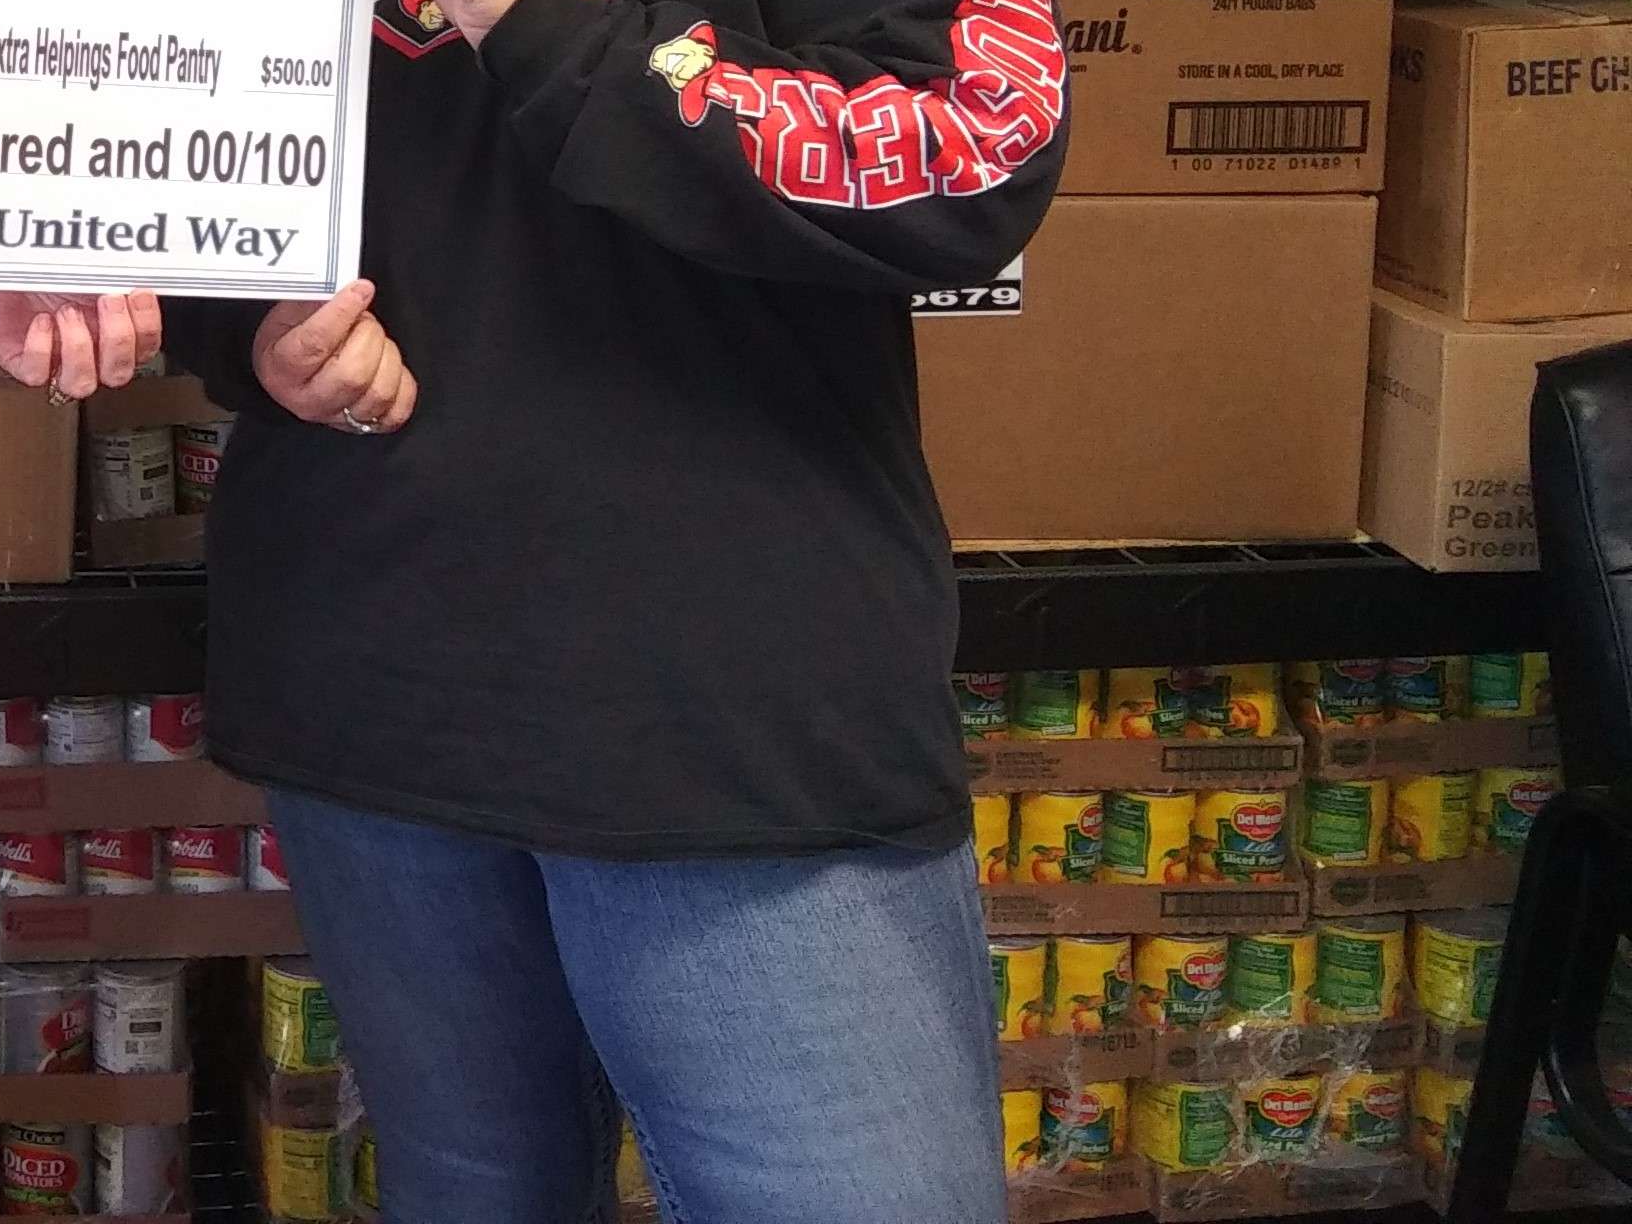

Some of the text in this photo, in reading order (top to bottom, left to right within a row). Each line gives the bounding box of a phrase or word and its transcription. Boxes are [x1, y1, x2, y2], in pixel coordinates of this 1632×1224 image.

[1066, 7, 1131, 54] ani
[35, 27, 112, 91] Helpings
[116, 31, 160, 81] Food
[167, 36, 222, 97] Pantry
[261, 55, 333, 88] $500.00
[1178, 63, 1345, 80] STORE IN A COOL, DRY PLACE
[1507, 58, 1582, 97] BEEF
[88, 127, 171, 181] and
[186, 129, 327, 187] 00/100
[1172, 157, 1361, 171] 1 00 71022 01489 1
[185, 214, 299, 267] Way
[1447, 504, 1535, 529] Peak
[1444, 536, 1536, 558] Green
[4, 1147, 64, 1177] DICED
